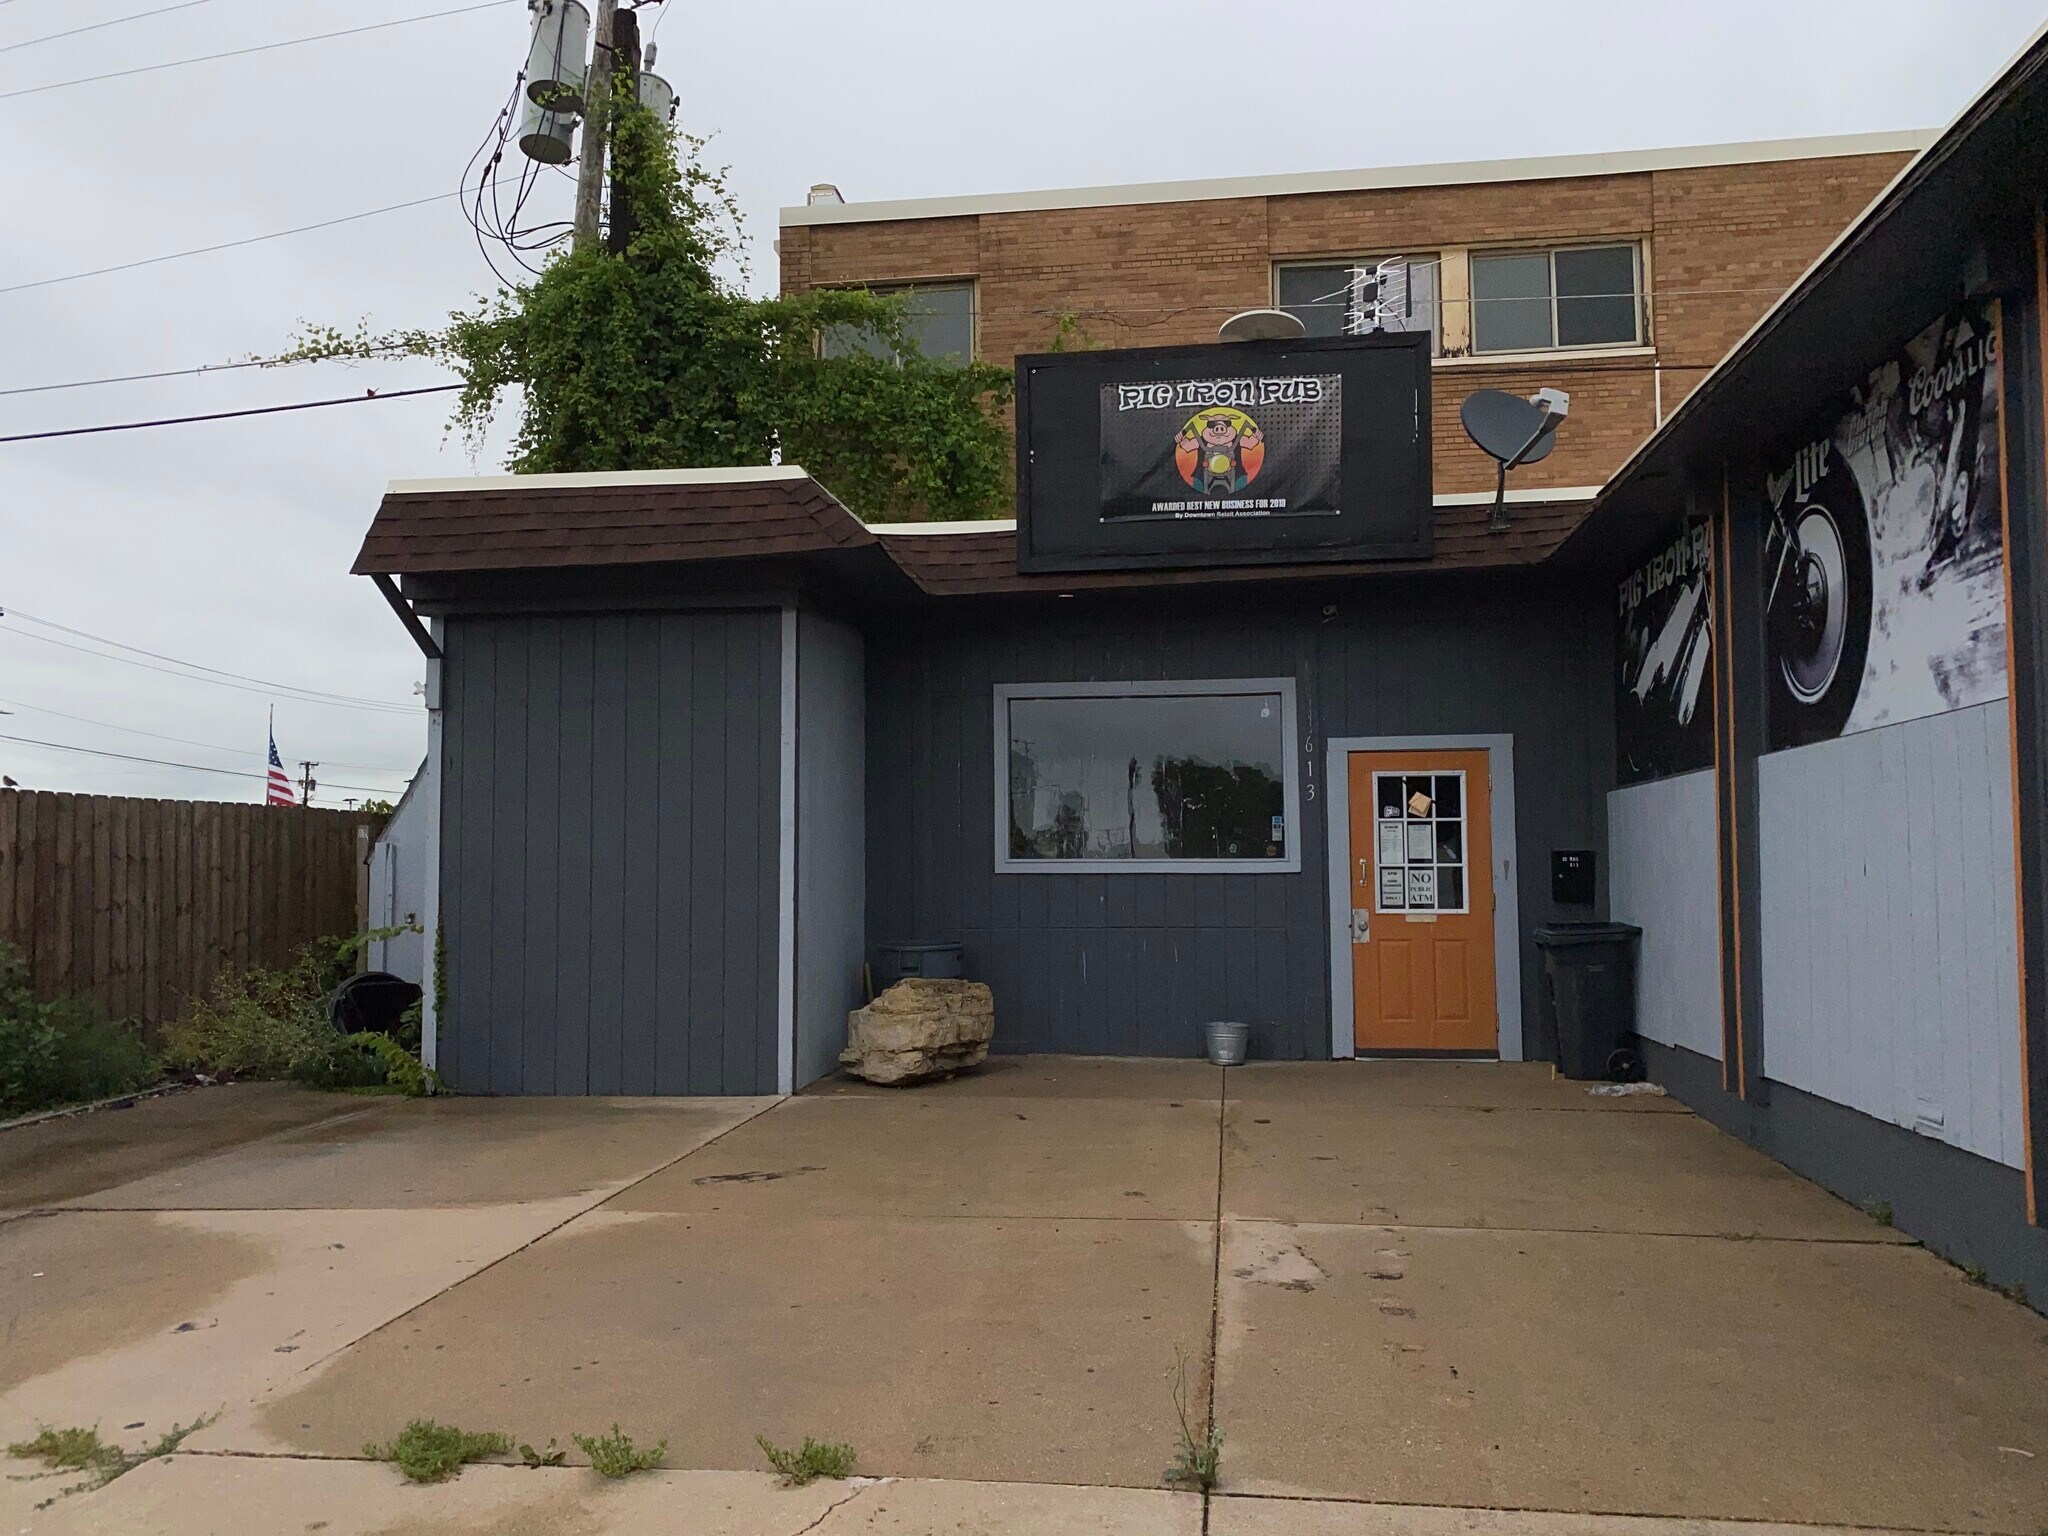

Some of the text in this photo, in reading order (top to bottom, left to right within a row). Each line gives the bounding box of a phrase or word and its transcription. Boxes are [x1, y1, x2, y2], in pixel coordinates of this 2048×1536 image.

[1119, 377, 1323, 411] PIG IRON PUB
[1907, 351, 1965, 415] Coors
[1795, 438, 1831, 503] Lite
[1152, 498, 1286, 512] AWARDED BEST NEW BUSINESS FOR 2019
[1618, 569, 1643, 618] PIG
[1645, 536, 1688, 598] IRON
[1411, 873, 1431, 884] NO
[1410, 894, 1433, 902] ATM
